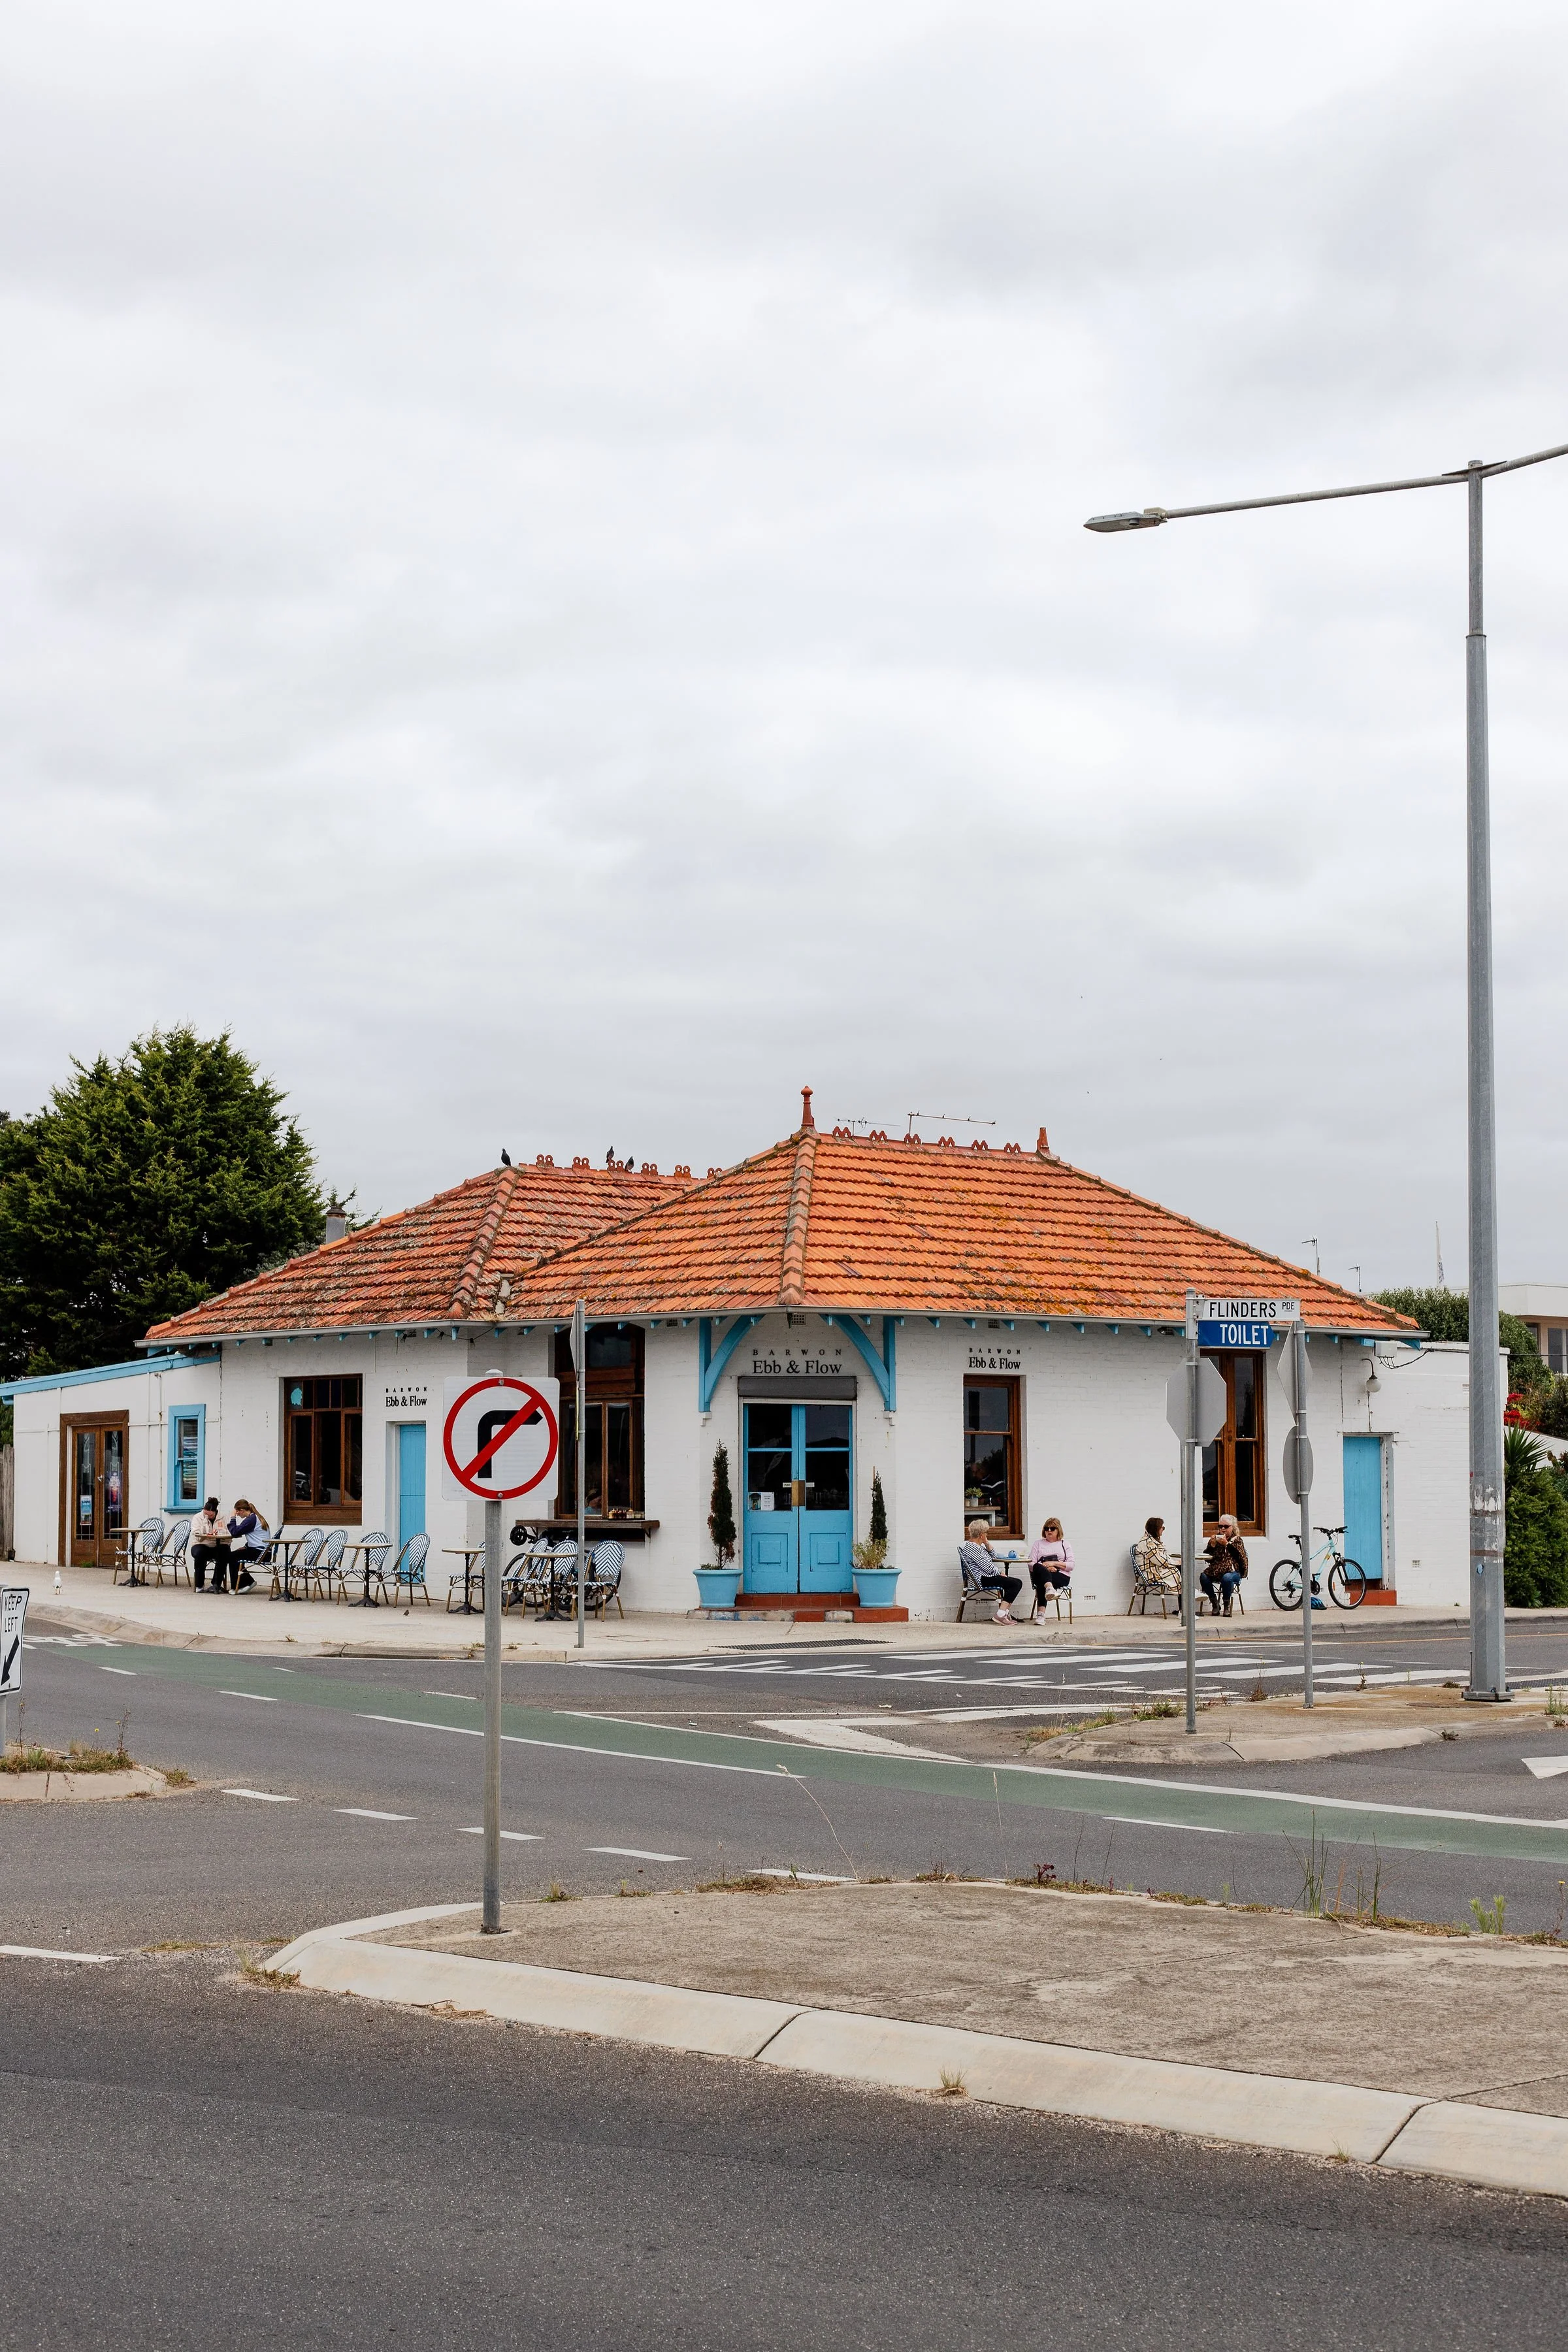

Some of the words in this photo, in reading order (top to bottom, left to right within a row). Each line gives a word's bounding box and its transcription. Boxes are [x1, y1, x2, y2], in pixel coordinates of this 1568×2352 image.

[1209, 1302, 1276, 1317] FLINDERS
[1282, 1301, 1295, 1310] PDE
[1220, 1324, 1269, 1345] TOILET
[752, 1360, 781, 1374] Ebb
[786, 1360, 800, 1374] &
[804, 1360, 842, 1374] Flow
[969, 1356, 987, 1368] Ebb
[988, 1357, 997, 1369] &
[999, 1358, 1021, 1369] Flow
[385, 1396, 399, 1407] Ebb
[400, 1396, 408, 1407] &
[409, 1395, 427, 1407] Flow
[5, 1595, 22, 1611] KEEP
[5, 1616, 18, 1633] LEFT
